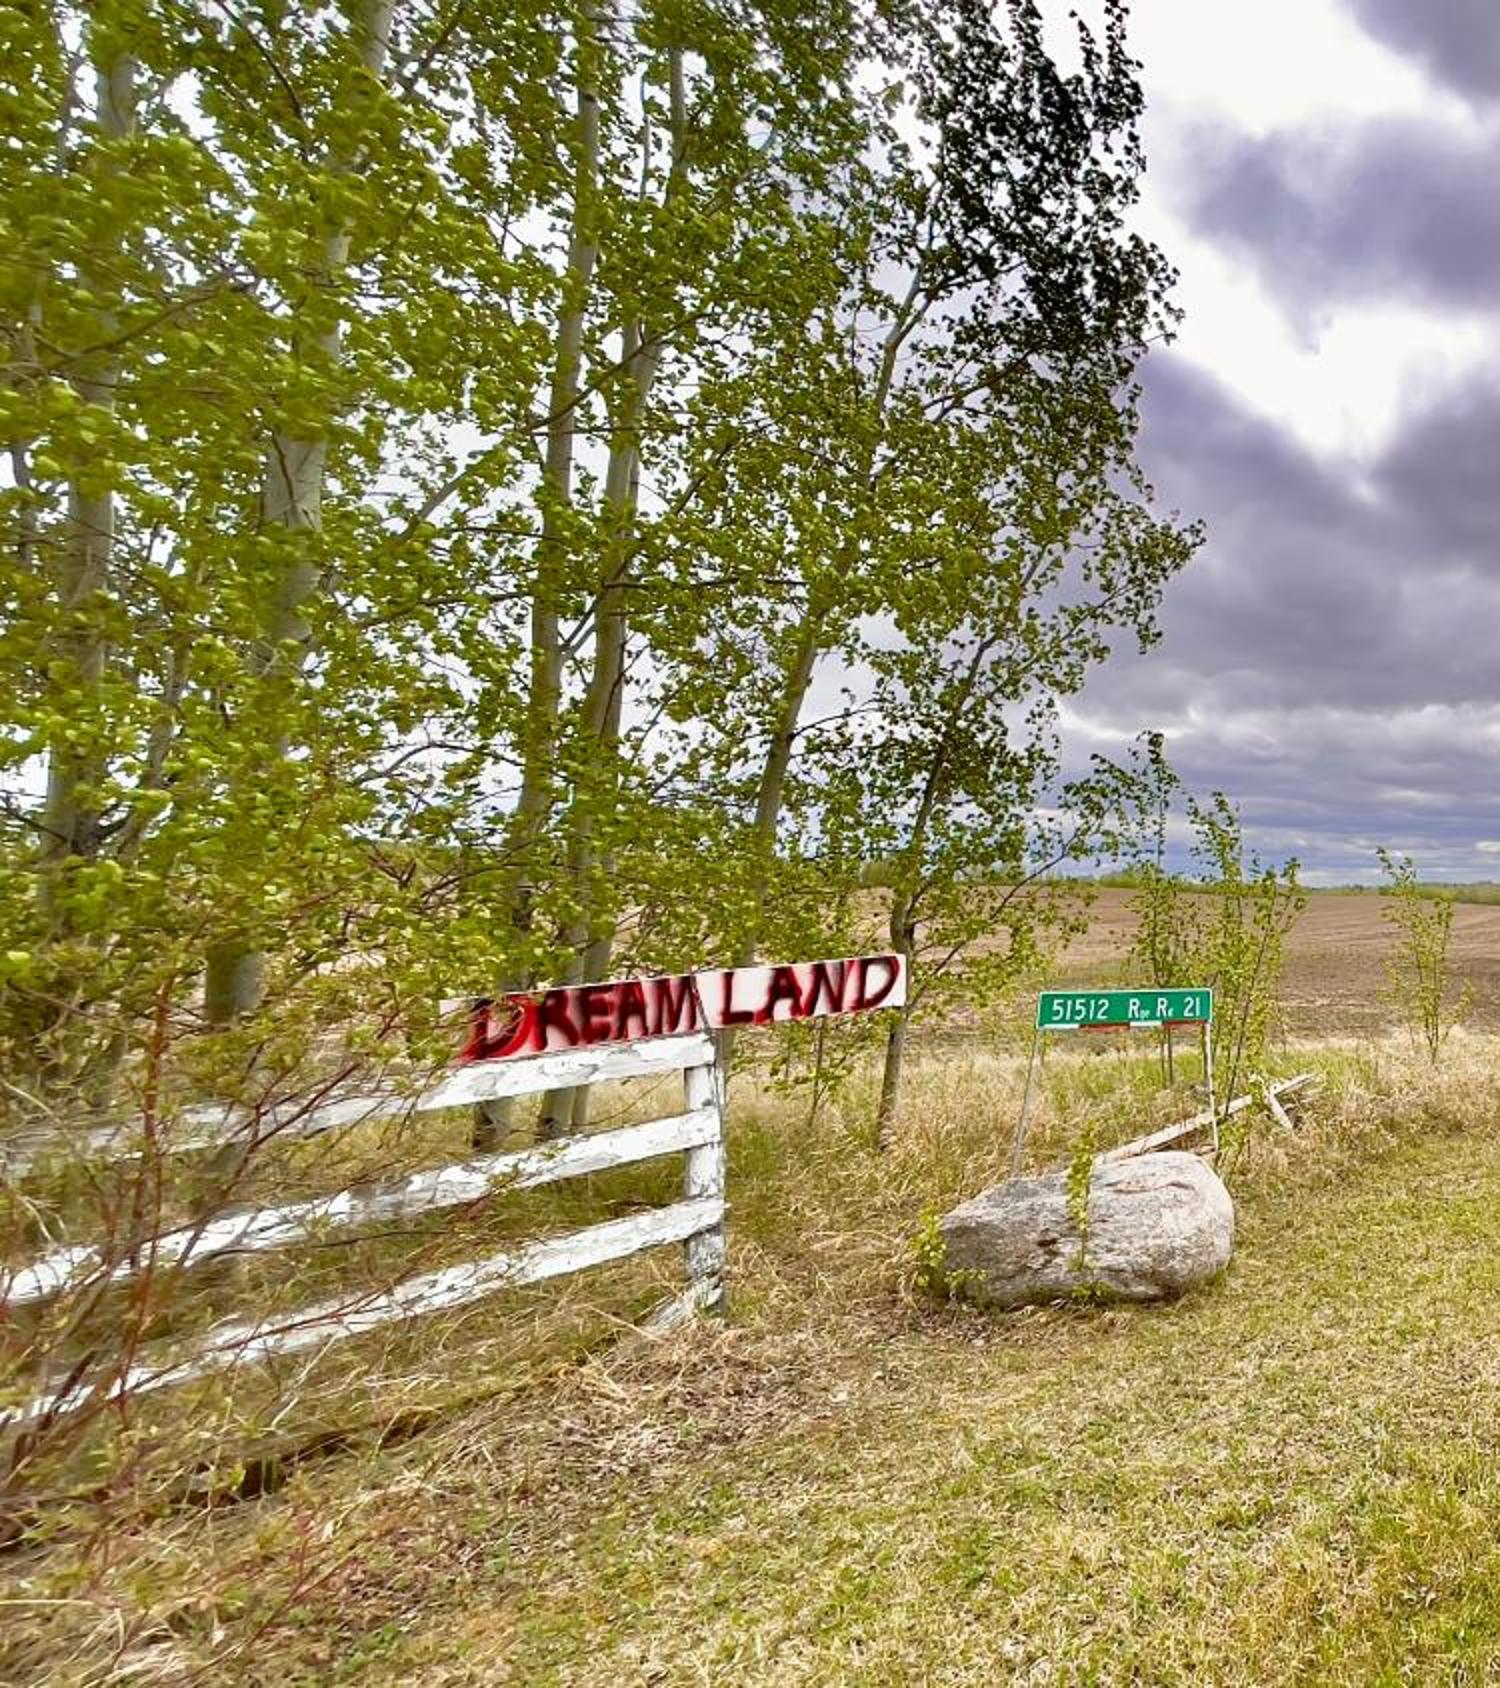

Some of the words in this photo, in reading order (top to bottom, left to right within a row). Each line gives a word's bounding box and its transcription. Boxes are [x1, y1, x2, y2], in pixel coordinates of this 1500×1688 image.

[459, 975, 697, 1061] DREAM
[720, 955, 900, 1025] LAND
[1052, 998, 1109, 1021] 51512
[1183, 996, 1200, 1017] 21
